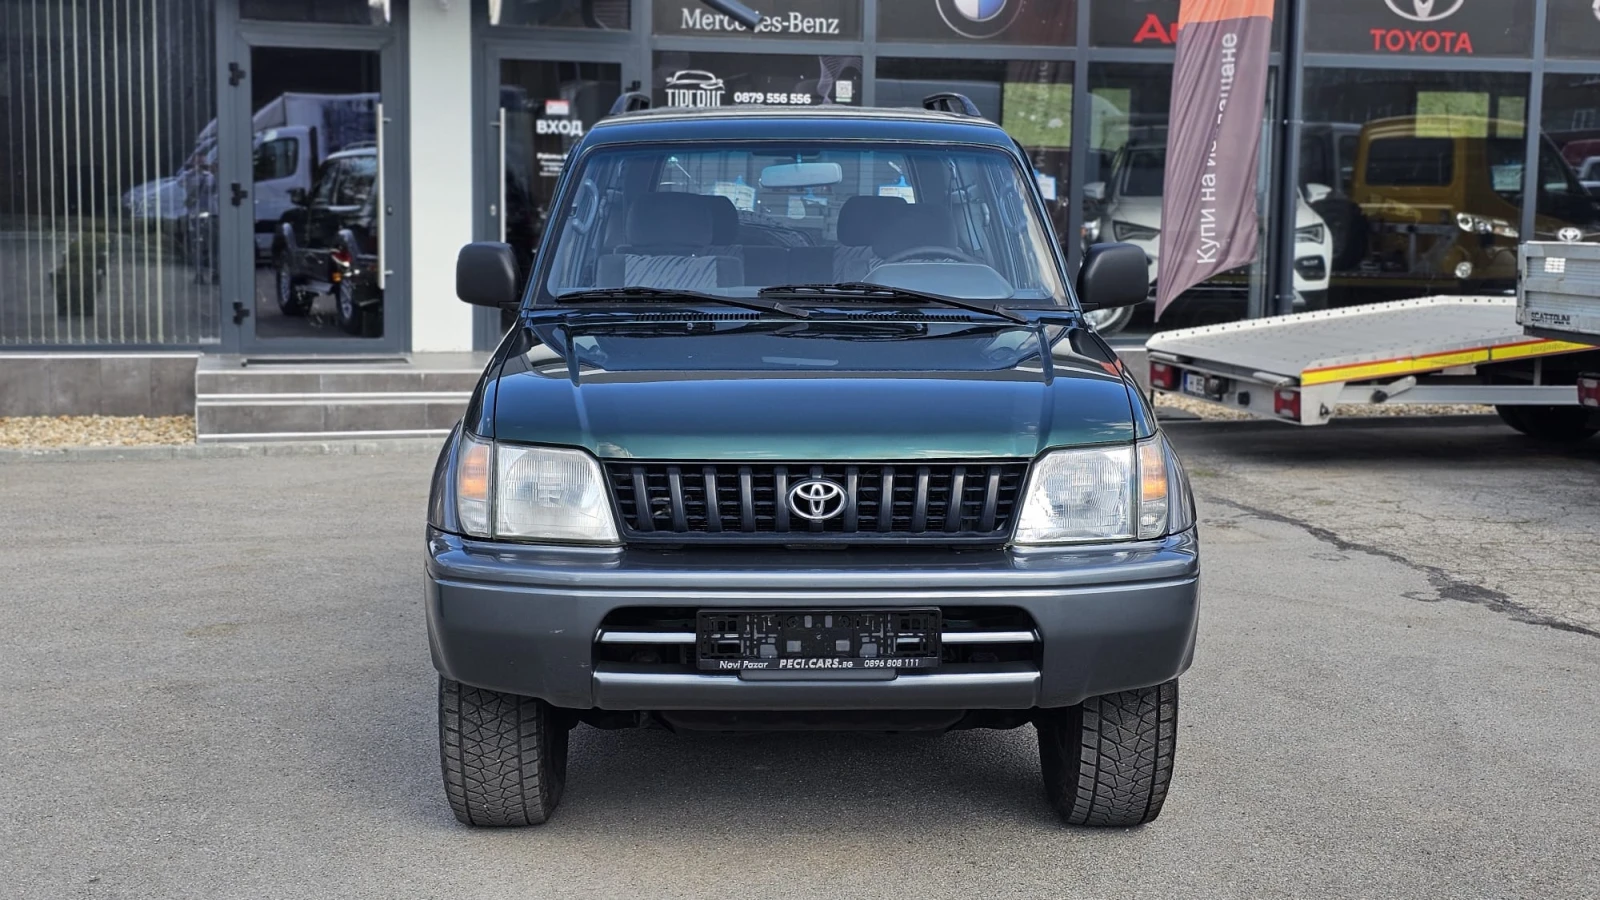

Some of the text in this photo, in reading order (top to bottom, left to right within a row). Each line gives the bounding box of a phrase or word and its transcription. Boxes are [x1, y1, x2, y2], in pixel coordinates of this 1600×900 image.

[680, 8, 840, 34] Merces-Benz
[1370, 29, 1473, 53] TOYOTA
[734, 91, 764, 103] 0879
[766, 92, 788, 104] 556
[789, 94, 812, 104] 556
[536, 120, 583, 136] ВХОД
[1201, 173, 1216, 202] на
[1197, 208, 1220, 264] Купи
[719, 660, 741, 669] Novi
[743, 661, 768, 669] Pazar
[864, 659, 885, 667] 0896
[886, 659, 903, 667] 808
[905, 658, 919, 667] 111
